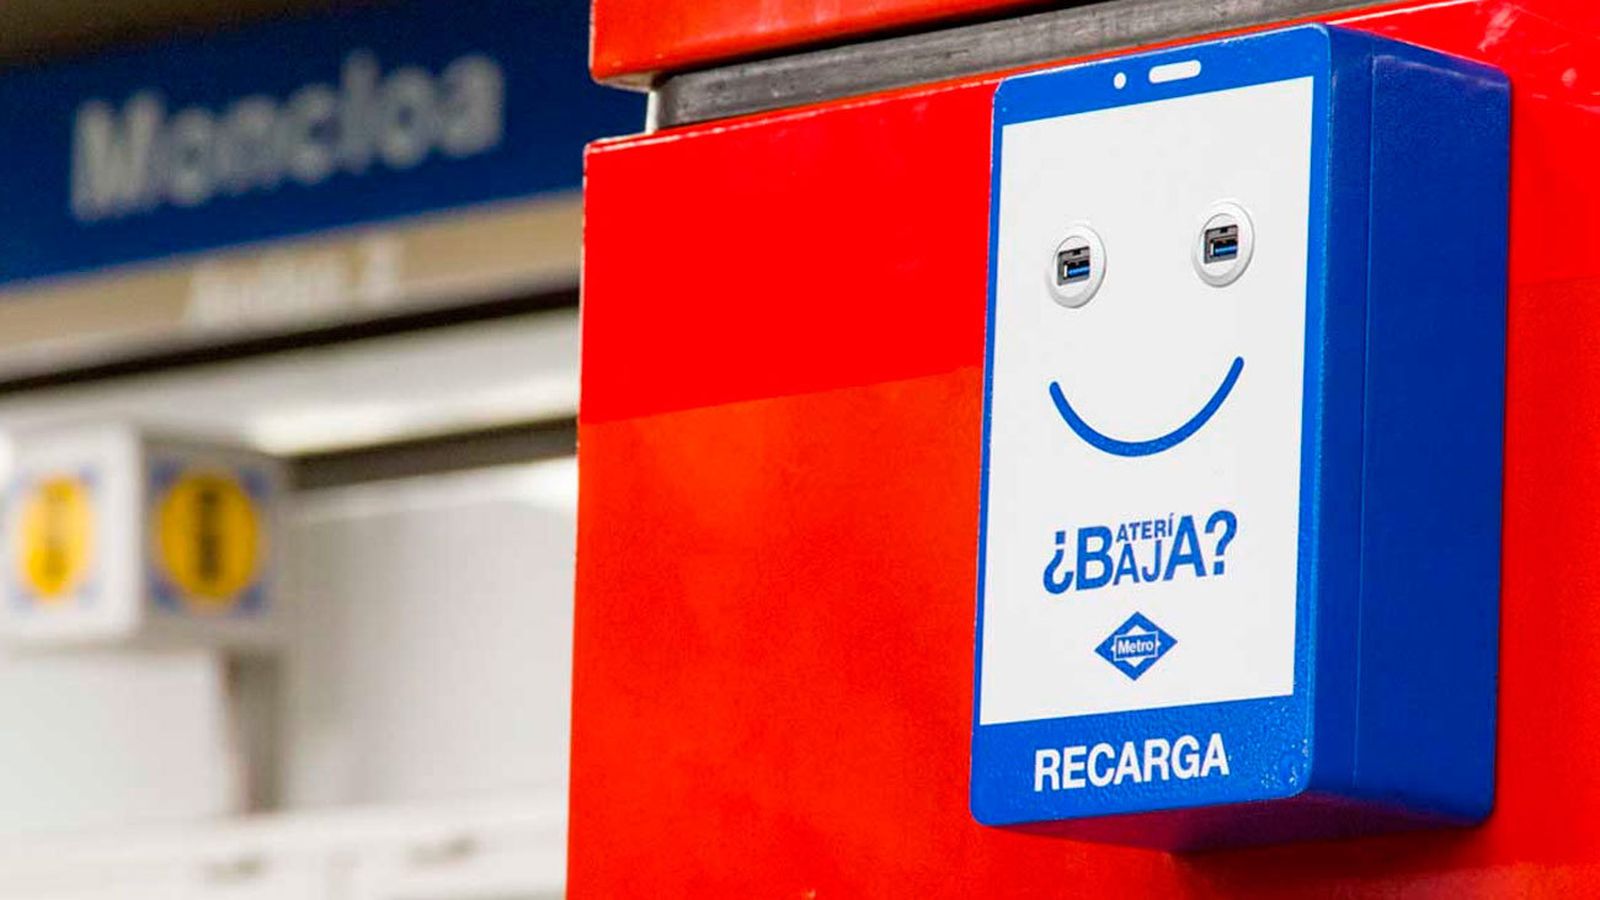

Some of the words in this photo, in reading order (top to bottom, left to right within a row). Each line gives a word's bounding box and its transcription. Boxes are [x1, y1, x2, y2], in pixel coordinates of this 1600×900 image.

[70, 50, 505, 221] Moncloa
[1118, 639, 1154, 655] Metro
[1034, 733, 1229, 792] RECARGA
